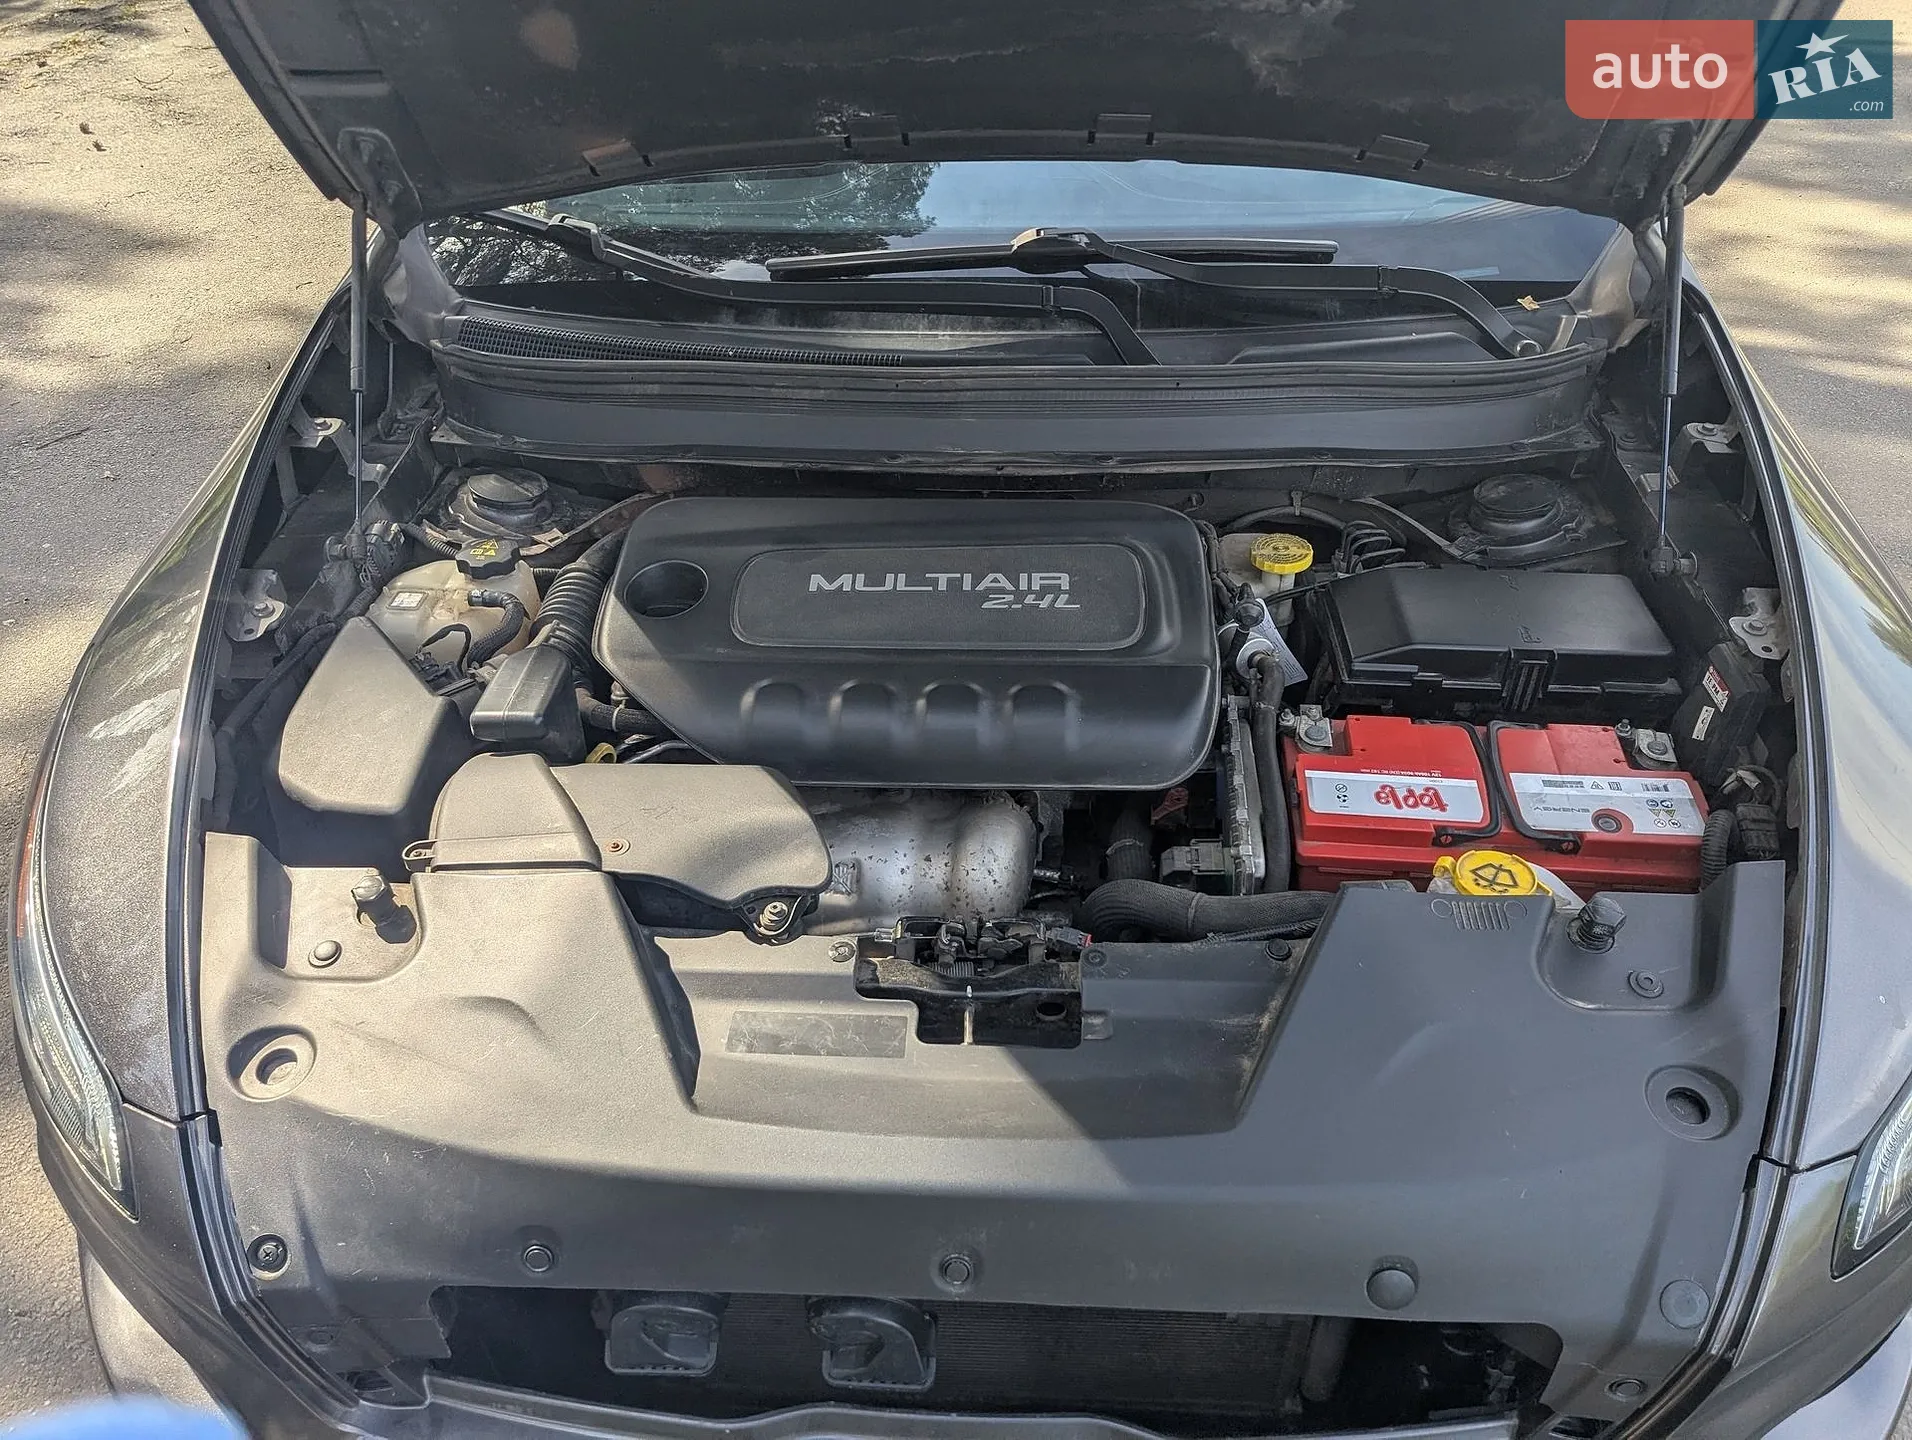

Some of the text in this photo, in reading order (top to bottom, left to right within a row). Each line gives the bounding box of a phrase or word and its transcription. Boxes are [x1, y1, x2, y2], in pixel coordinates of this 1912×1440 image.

[808, 572, 1070, 592] MULTIAIR
[981, 593, 1082, 609] 2.4L
[1533, 806, 1591, 814] ENERGY
